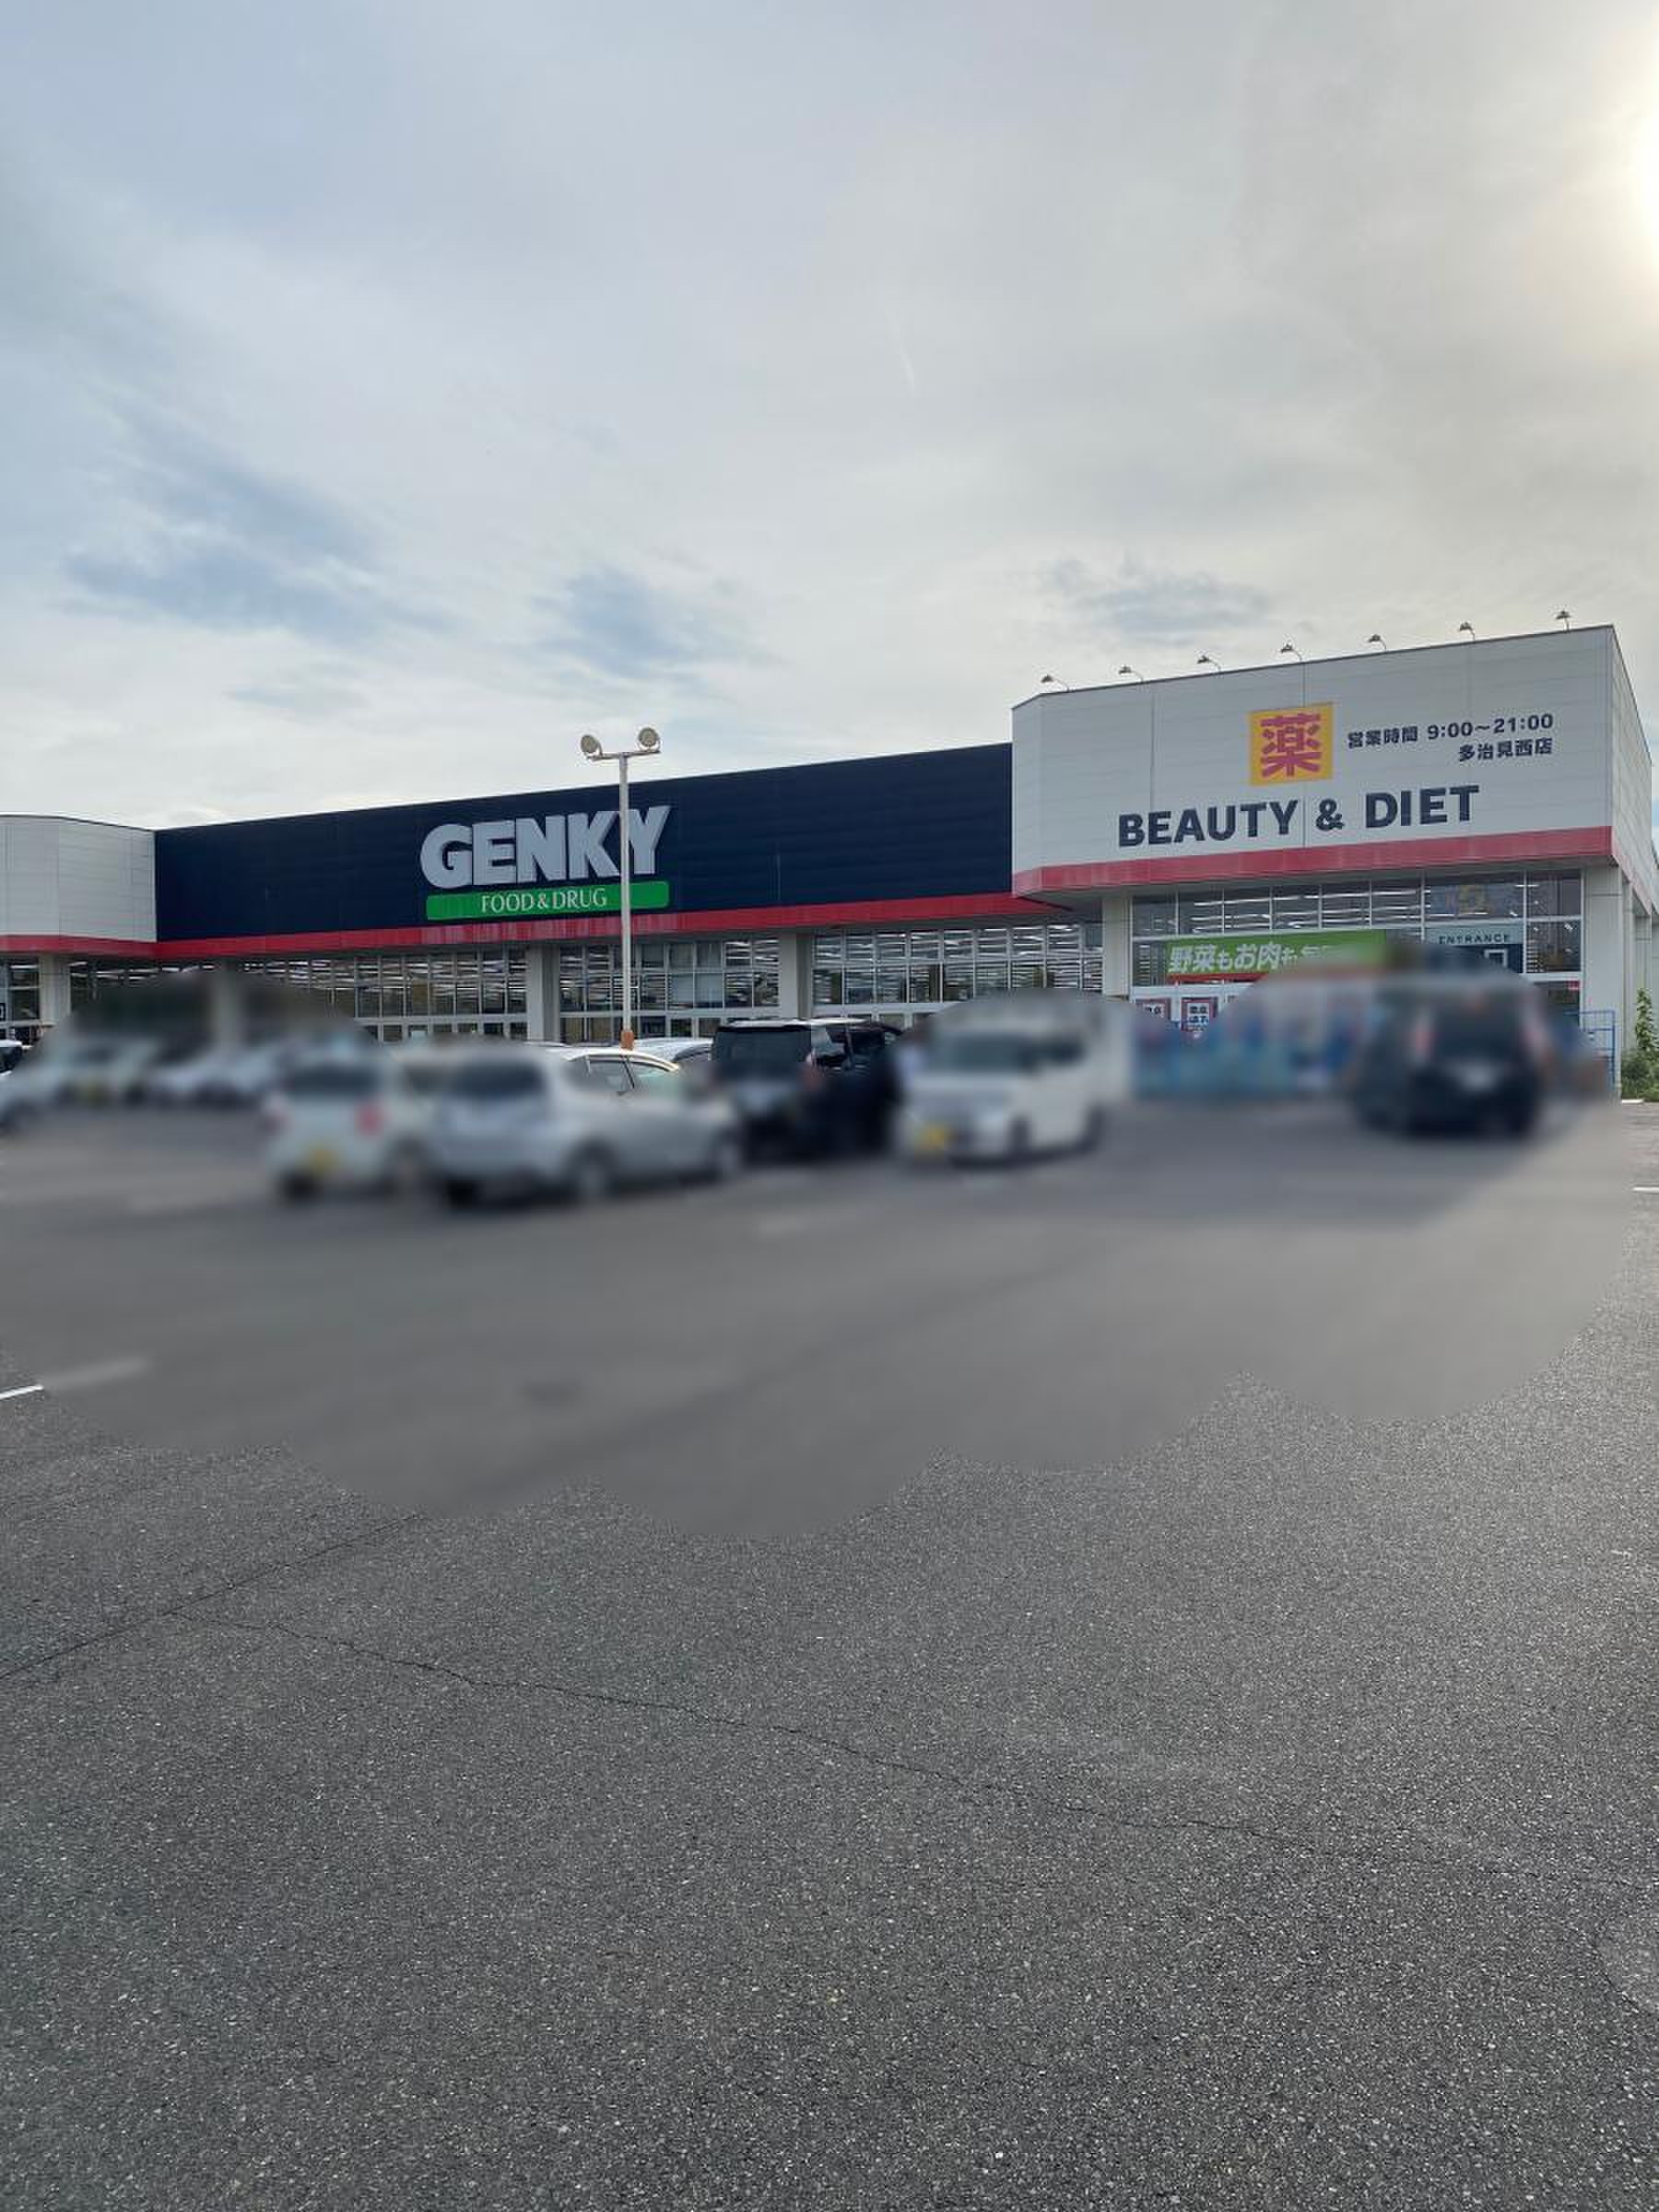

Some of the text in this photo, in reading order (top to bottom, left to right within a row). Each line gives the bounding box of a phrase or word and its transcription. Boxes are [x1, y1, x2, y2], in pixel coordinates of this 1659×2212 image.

[1260, 712, 1322, 777] 薬
[1347, 725, 1418, 748] 営業時間
[1458, 736, 1553, 761] 多治見西店
[1118, 784, 1479, 847] BEAUTY & DIET
[419, 805, 672, 889] GENKY
[1439, 934, 1511, 945] ENTRANCE
